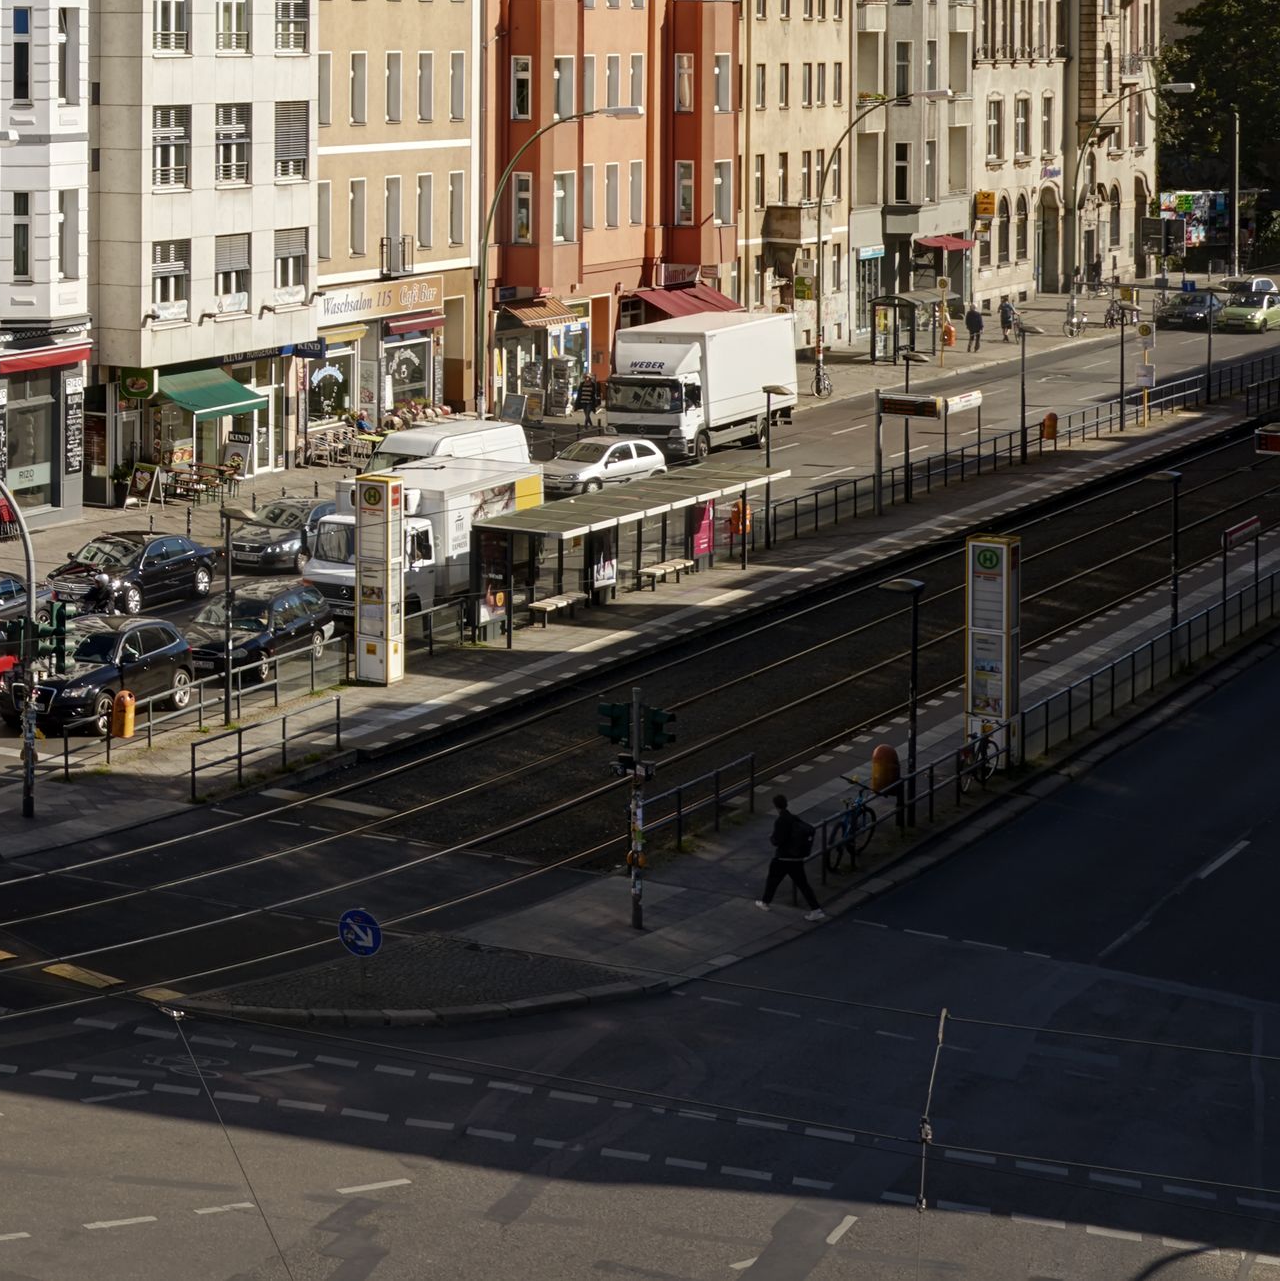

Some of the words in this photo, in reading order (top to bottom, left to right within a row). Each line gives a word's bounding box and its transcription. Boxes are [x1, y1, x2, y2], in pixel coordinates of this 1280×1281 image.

[323, 293, 372, 316] Waschsalon
[376, 290, 392, 307] 115
[420, 282, 437, 303] Bar
[297, 342, 321, 351] KIND
[630, 361, 665, 370] WEBER
[228, 433, 250, 442] KIND
[18, 469, 34, 478] RIZO
